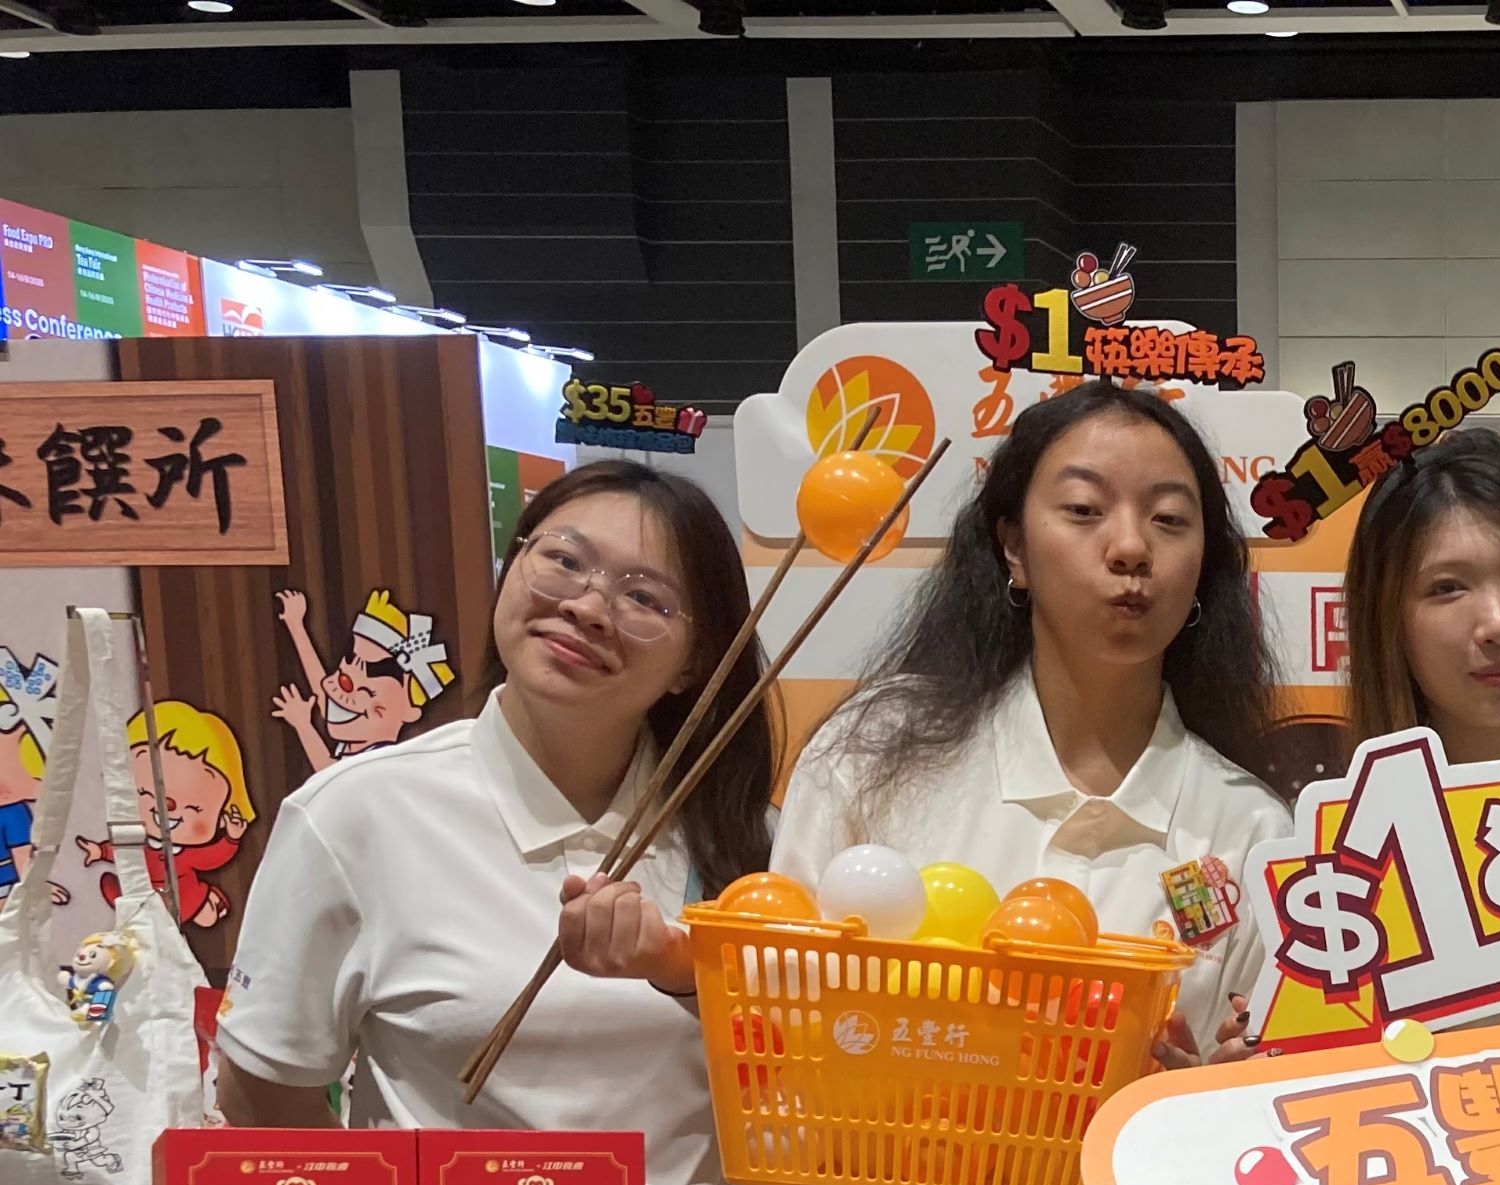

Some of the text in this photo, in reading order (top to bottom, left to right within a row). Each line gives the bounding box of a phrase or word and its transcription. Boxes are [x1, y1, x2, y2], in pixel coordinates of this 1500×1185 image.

[3, 224, 20, 241] Food
[21, 228, 38, 246] Expo
[975, 283, 1083, 374] $1
[563, 378, 632, 424] $35
[0, 417, 246, 536] 饌所
[1250, 445, 1362, 542] $1
[891, 1045, 1000, 1067] NG FUNG HONG
